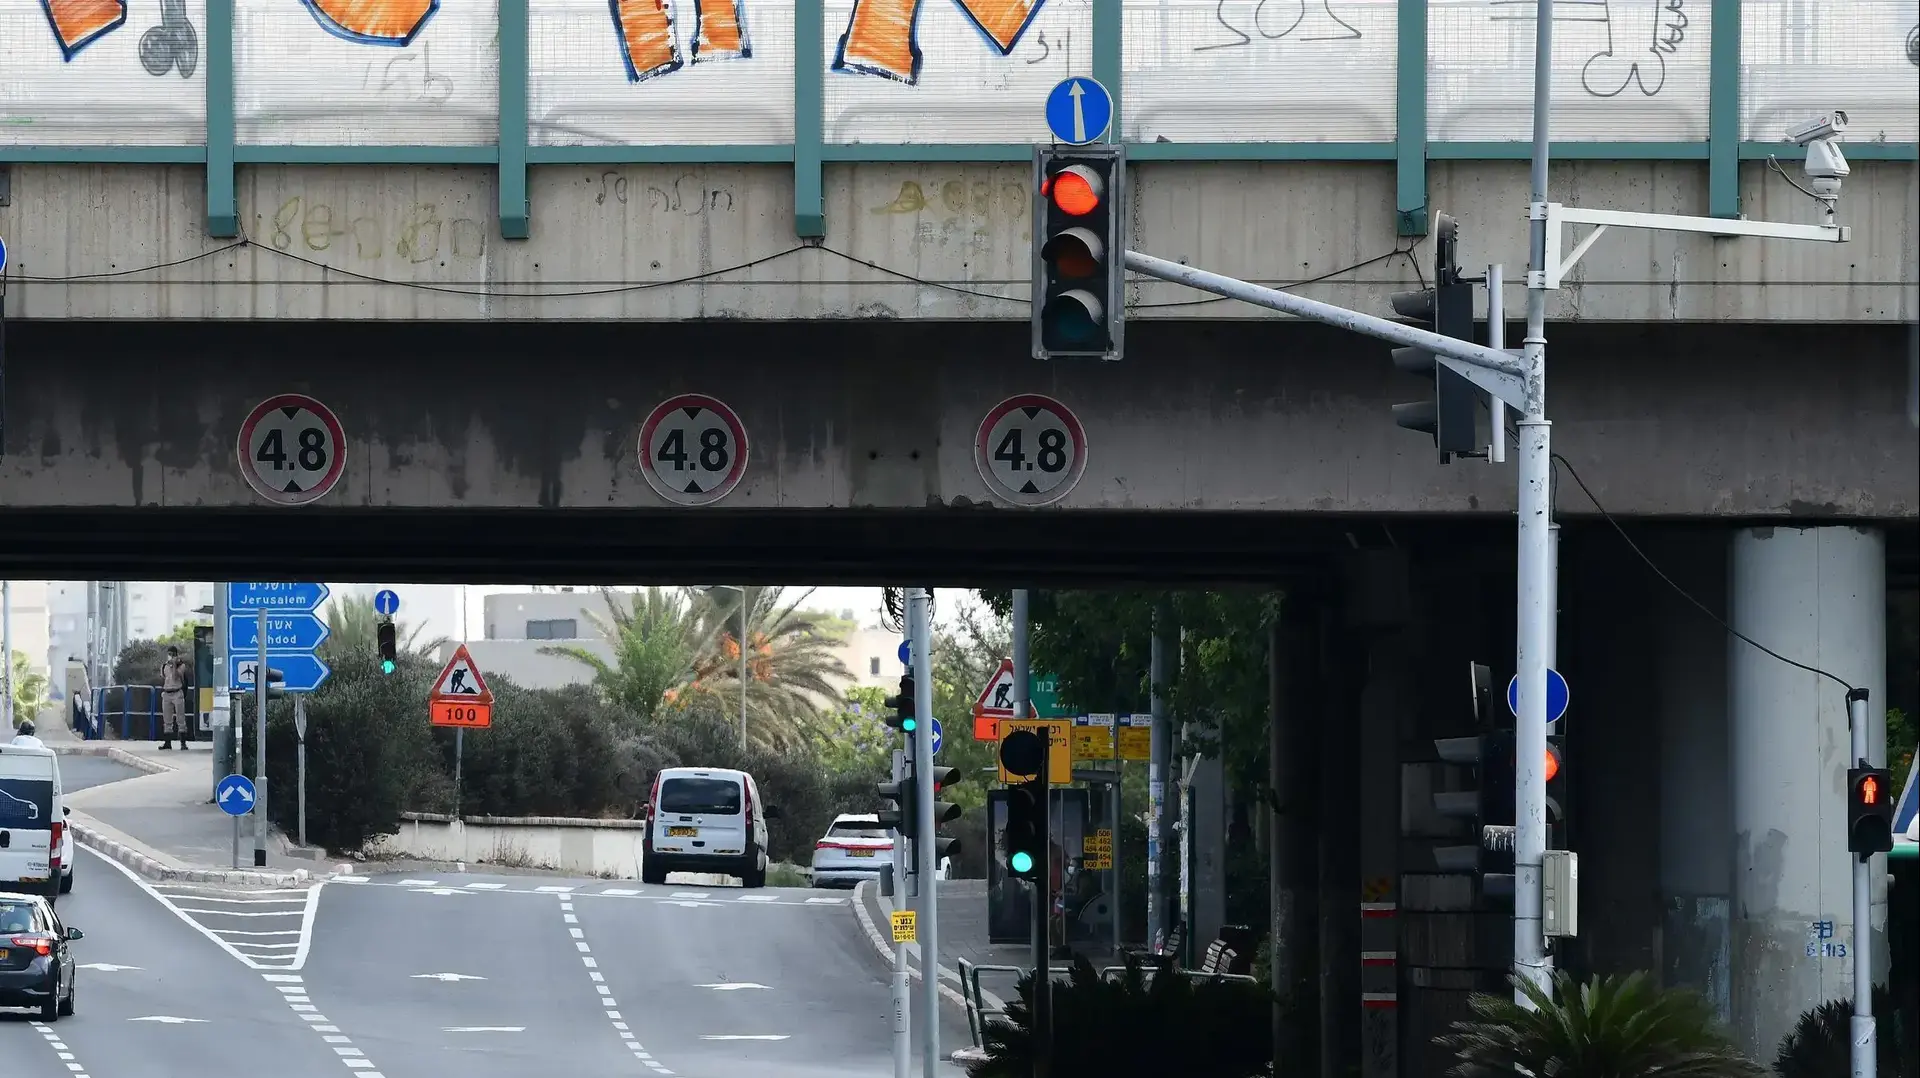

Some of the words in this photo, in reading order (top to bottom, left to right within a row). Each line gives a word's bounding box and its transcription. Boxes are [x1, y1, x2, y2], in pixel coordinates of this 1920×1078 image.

[256, 428, 327, 471] 4.8
[657, 428, 728, 470] 4.8
[994, 428, 1066, 472] 4.8
[240, 595, 306, 604] Jerusalem
[253, 620, 293, 630] אשדד
[250, 634, 297, 644] Ahdod
[446, 707, 476, 721] 100
